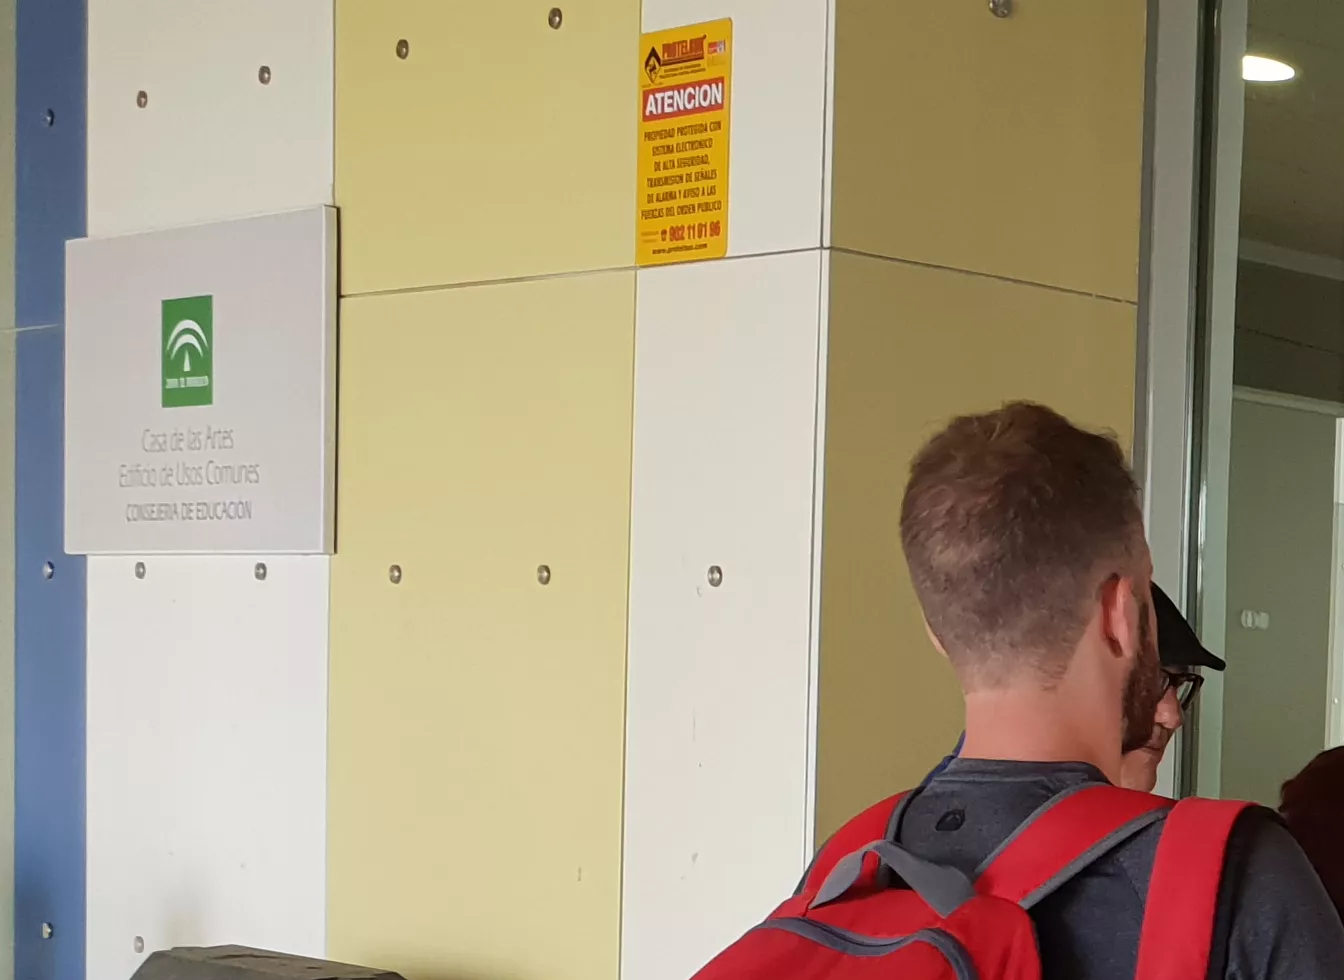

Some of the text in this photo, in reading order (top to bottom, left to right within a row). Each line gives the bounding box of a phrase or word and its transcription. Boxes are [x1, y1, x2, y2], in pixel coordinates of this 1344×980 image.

[645, 83, 723, 116] ATENCION
[654, 160, 660, 171] DE
[662, 159, 674, 170] ALTA
[685, 172, 692, 182] DE
[647, 193, 653, 203] DE
[706, 184, 716, 195] LAS
[669, 224, 684, 241] 902
[141, 425, 234, 453] Casa de las Artes
[159, 462, 174, 487] de
[176, 462, 203, 486] Usos
[206, 460, 260, 484] Comunes
[181, 502, 194, 520] DE
